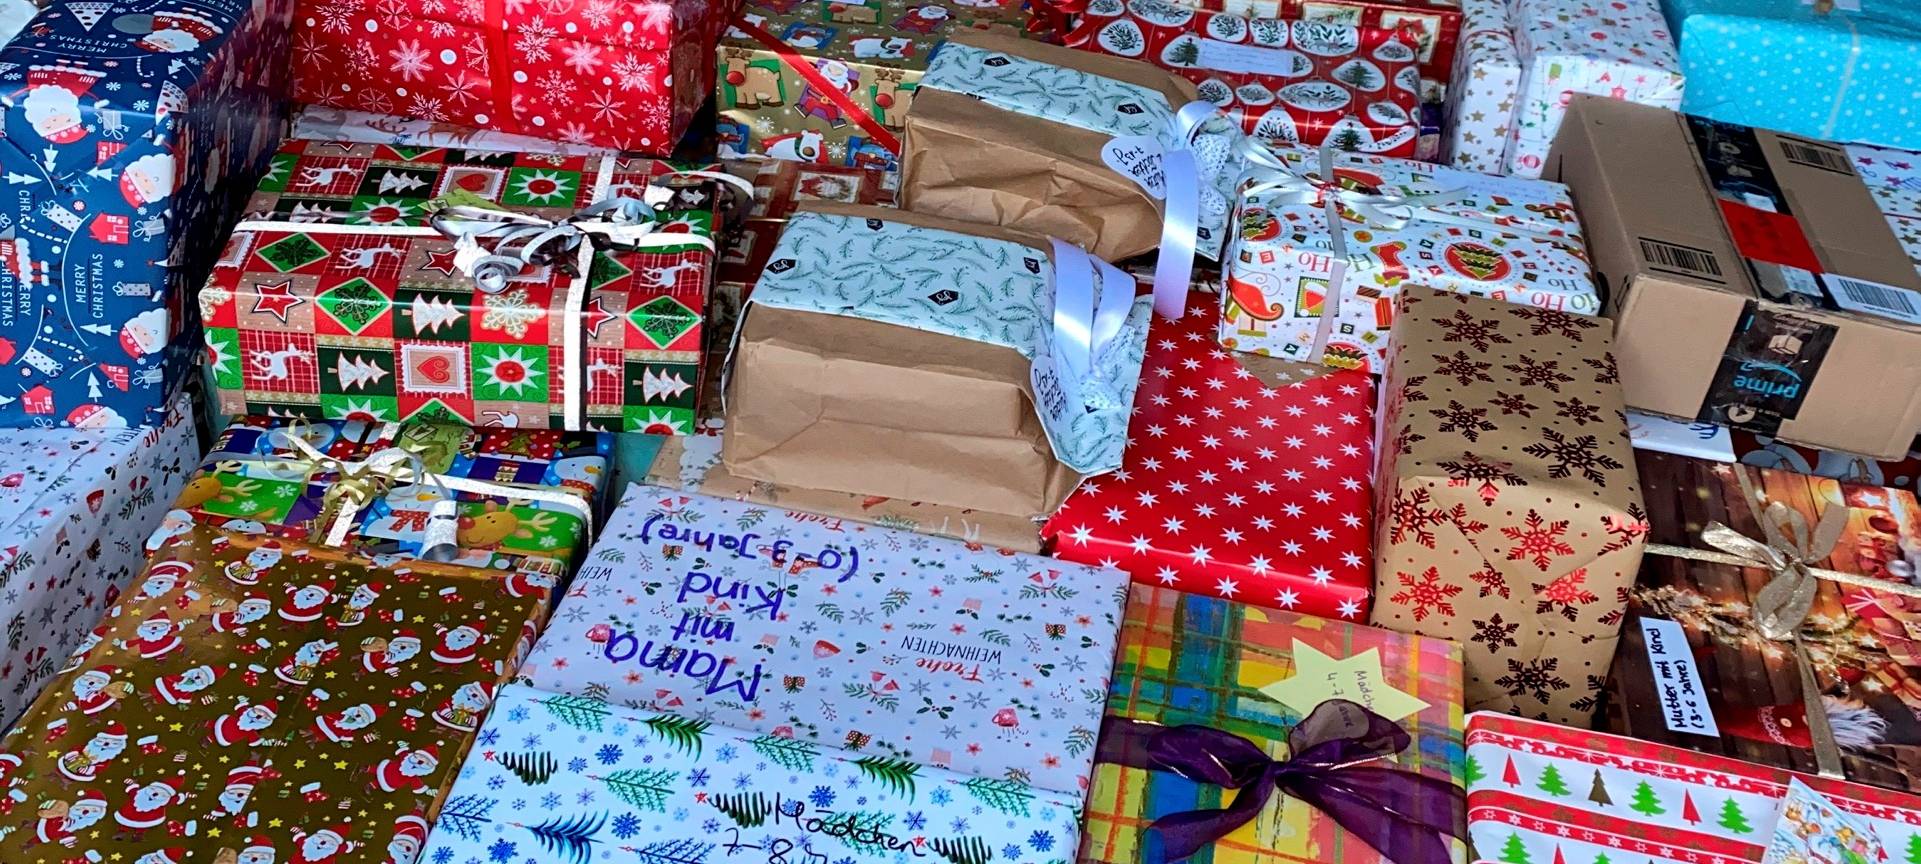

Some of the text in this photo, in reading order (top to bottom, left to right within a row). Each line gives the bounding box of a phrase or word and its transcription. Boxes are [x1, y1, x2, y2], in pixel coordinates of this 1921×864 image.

[49, 33, 128, 50] CHRISTMAS
[57, 43, 107, 54] MERRY
[1298, 252, 1331, 273] Ho
[1, 261, 13, 327] HRISTMAS
[18, 282, 31, 316] ERRY
[74, 263, 87, 303] MERRY
[92, 253, 104, 319] CHRISTMAS
[1734, 374, 1800, 399] prime
[641, 512, 761, 560] Jahre)
[676, 571, 785, 621] Kind
[670, 611, 735, 642] mit
[603, 628, 762, 702] Mama
[900, 635, 1002, 665] WEIHNACHTEN
[915, 658, 984, 684] Frohe
[1646, 627, 1688, 729] Mutter mit Kind
